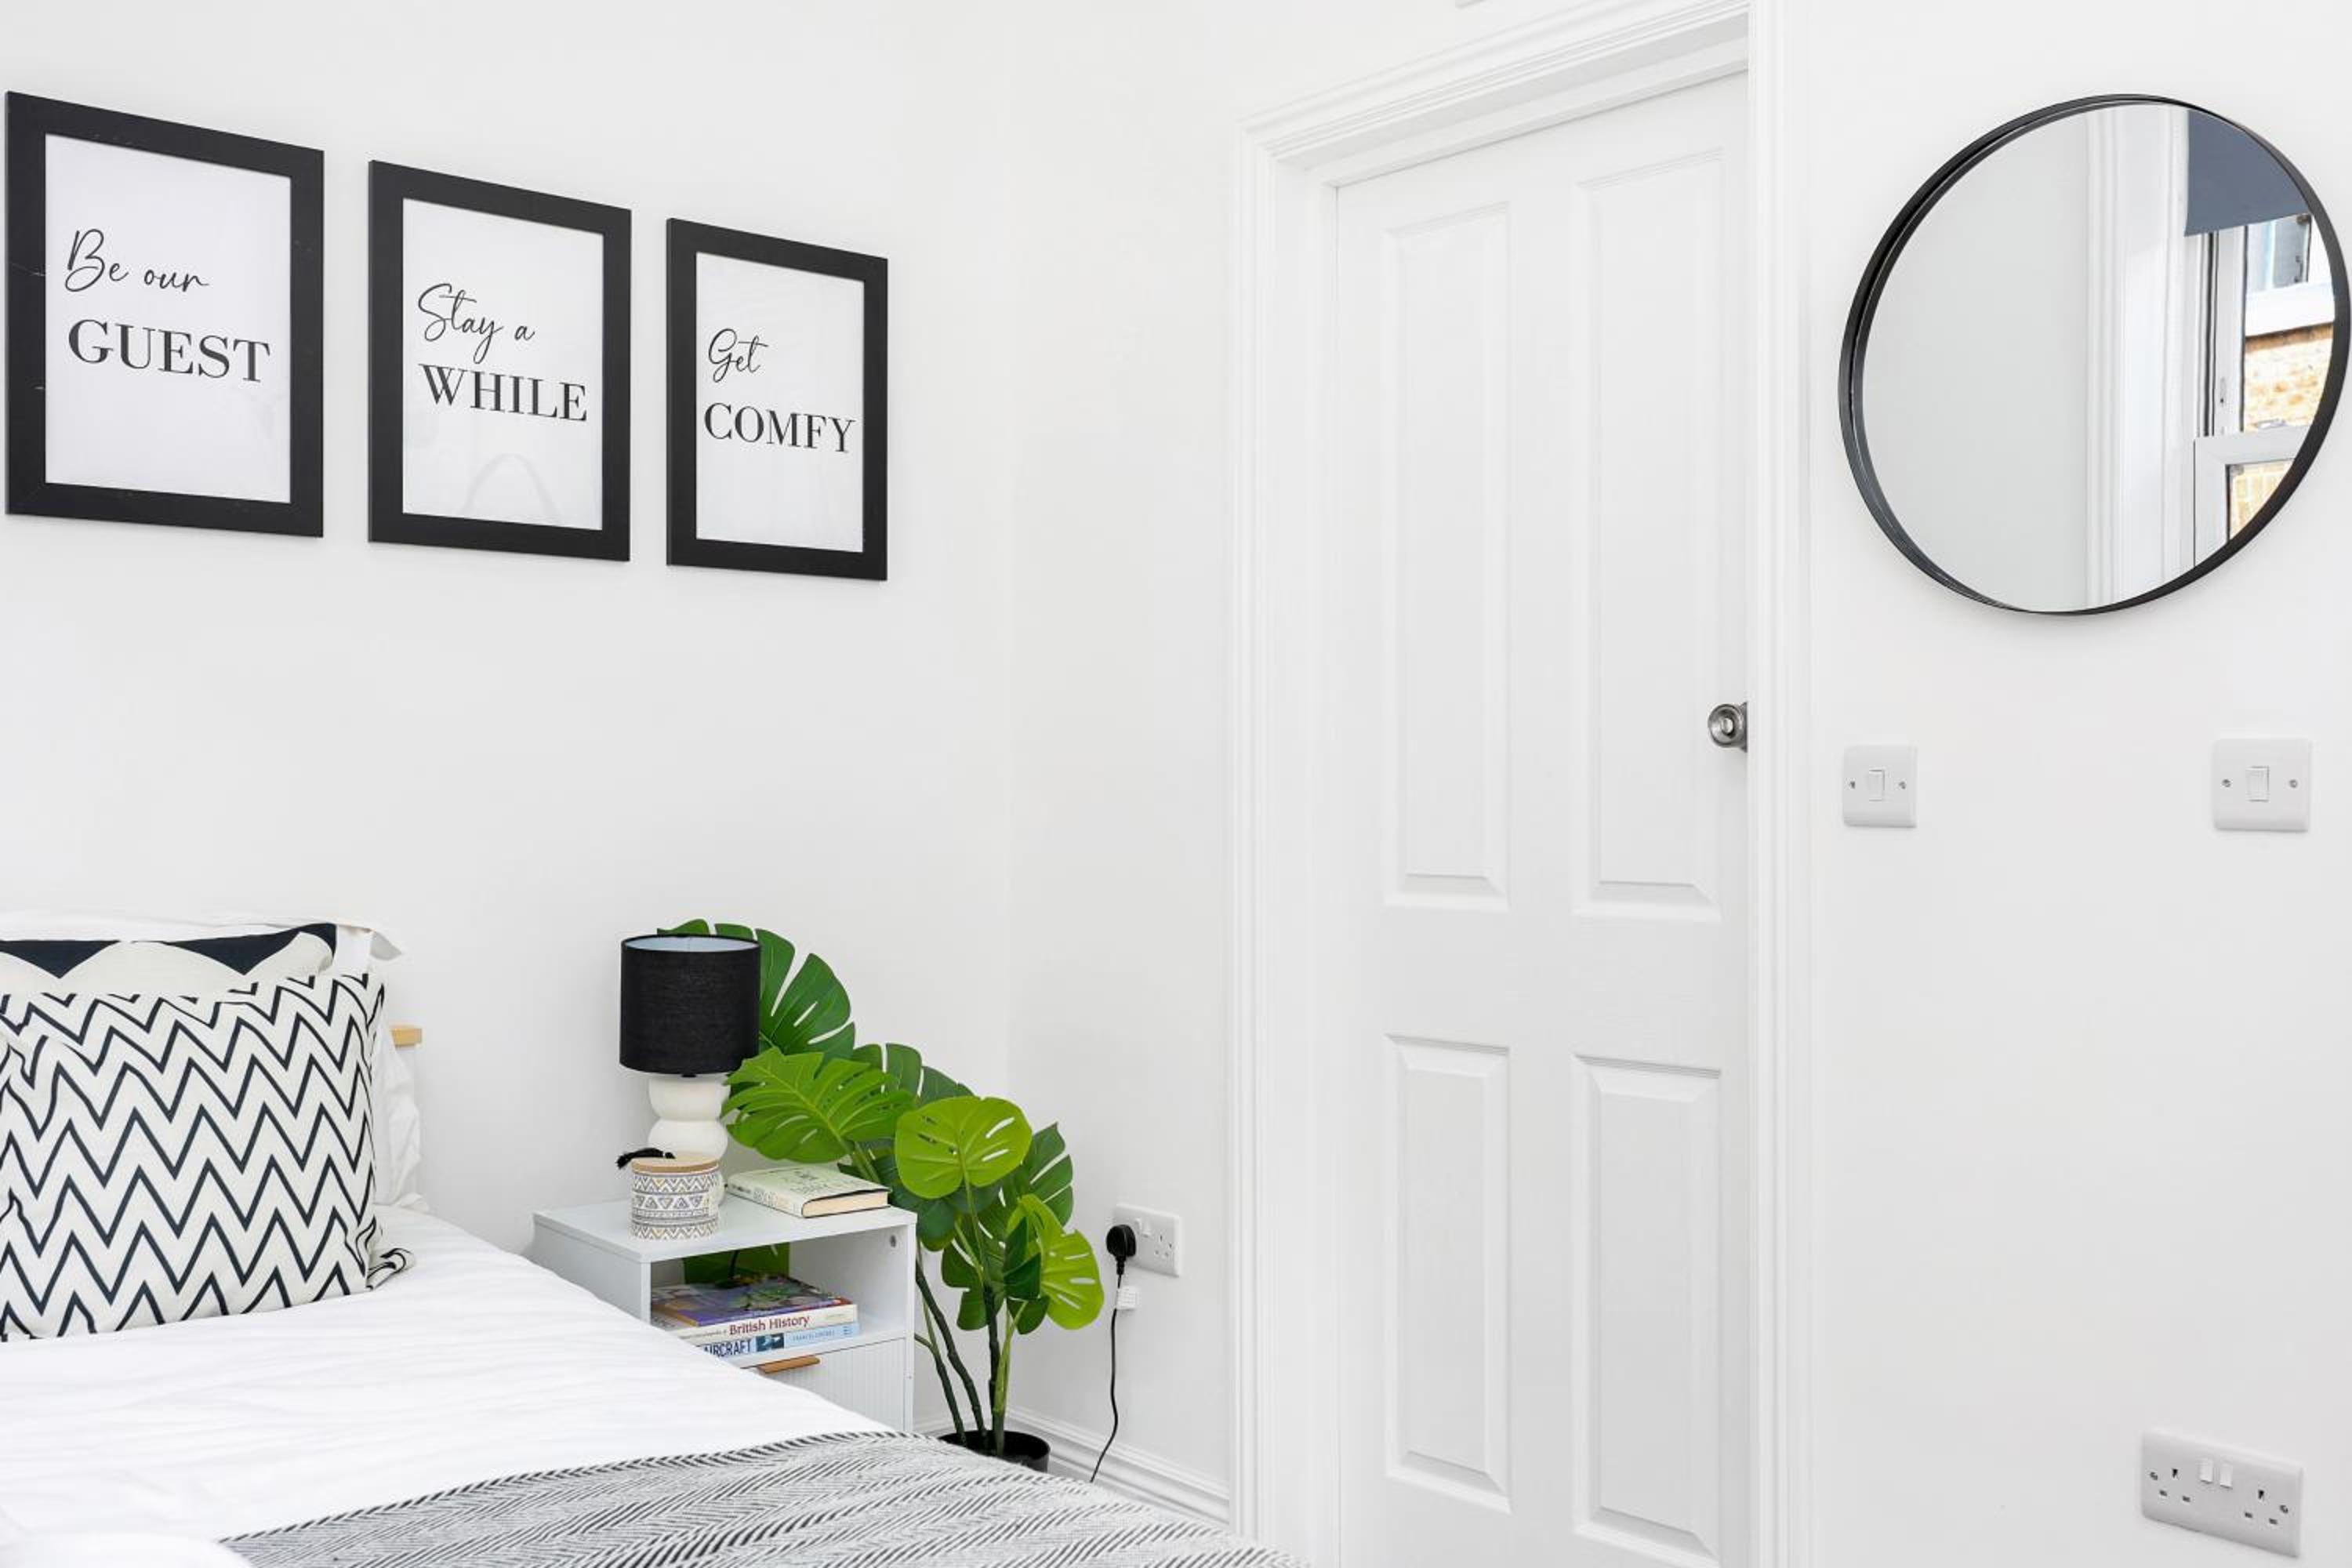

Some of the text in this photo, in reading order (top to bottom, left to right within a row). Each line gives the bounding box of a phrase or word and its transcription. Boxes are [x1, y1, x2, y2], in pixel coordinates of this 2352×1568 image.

[64, 228, 209, 293] Be our
[68, 319, 271, 383] GUEST
[417, 283, 536, 364] Stay a
[708, 328, 769, 383] Get
[418, 363, 588, 422] WHILE
[703, 402, 856, 453] COMFY
[730, 1319, 766, 1335] British
[769, 1316, 810, 1330] History
